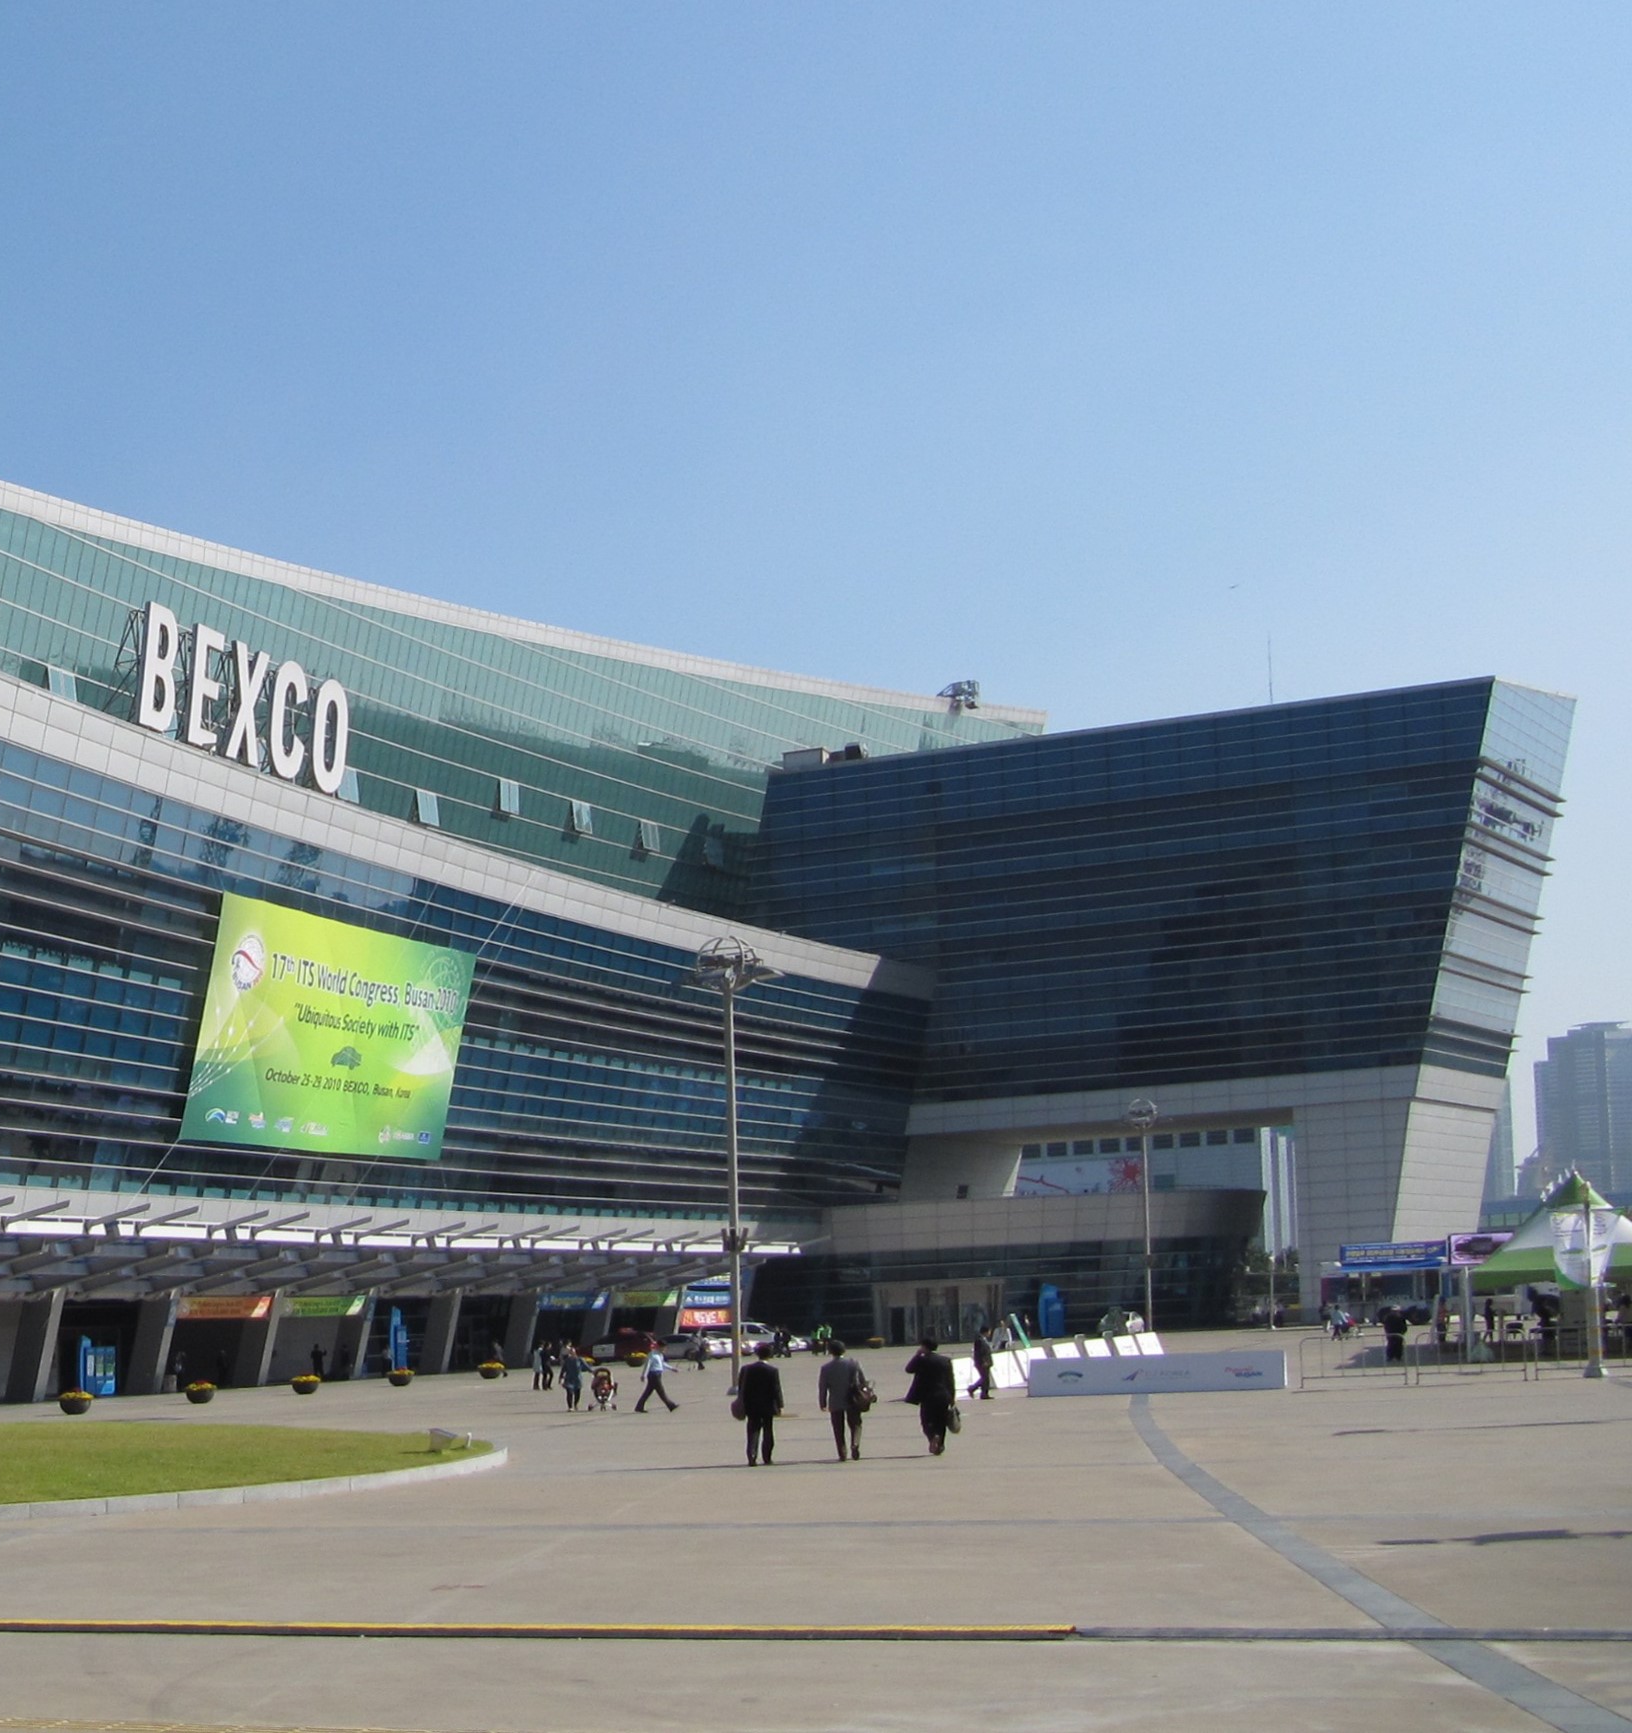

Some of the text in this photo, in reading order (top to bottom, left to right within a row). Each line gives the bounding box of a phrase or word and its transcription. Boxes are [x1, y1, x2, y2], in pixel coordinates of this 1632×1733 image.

[138, 601, 349, 794] BEXCO
[271, 953, 296, 979] 17th
[296, 958, 316, 988] ITS
[317, 963, 349, 995] World
[348, 971, 402, 1009] Congress,
[404, 982, 435, 1009] Busan
[435, 987, 459, 1014] 2010
[342, 1013, 378, 1040] Society
[377, 1021, 400, 1039] with
[265, 1067, 301, 1085] October
[322, 1077, 342, 1091] 2010
[342, 1081, 371, 1096] BEXCO,
[372, 1083, 395, 1100] Busan,
